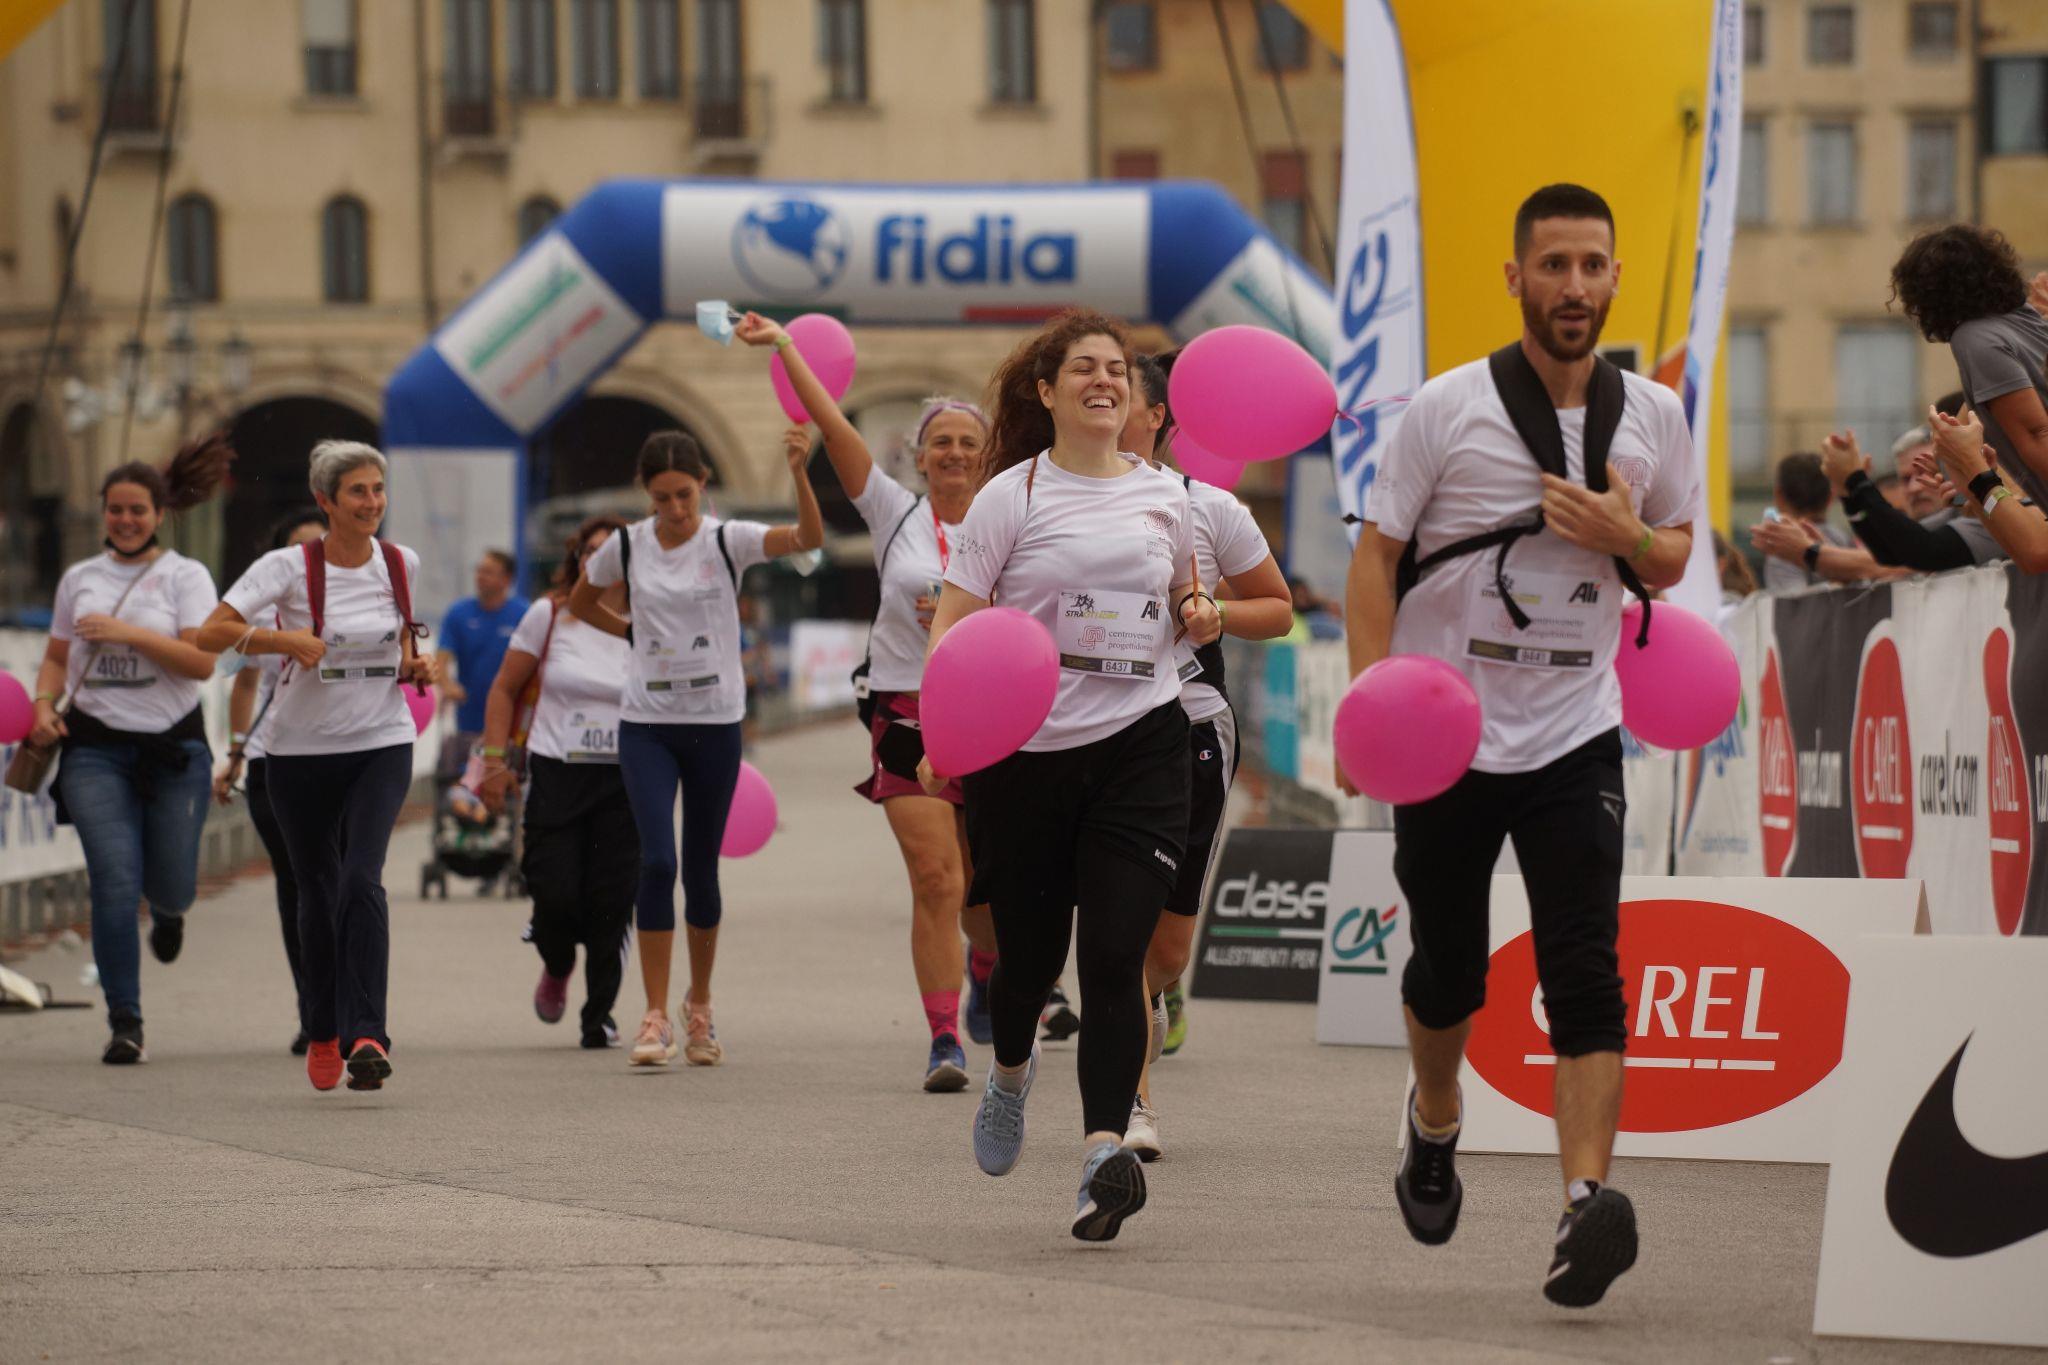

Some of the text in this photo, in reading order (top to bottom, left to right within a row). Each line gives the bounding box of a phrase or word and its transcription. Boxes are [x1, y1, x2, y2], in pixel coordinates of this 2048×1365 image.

[877, 214, 1077, 284] fidia
[96, 655, 138, 679] 4027
[1105, 661, 1129, 673] 6437
[580, 728, 618, 752] 404
[1862, 717, 1905, 805] CAREL
[1531, 964, 1781, 1041] REL
